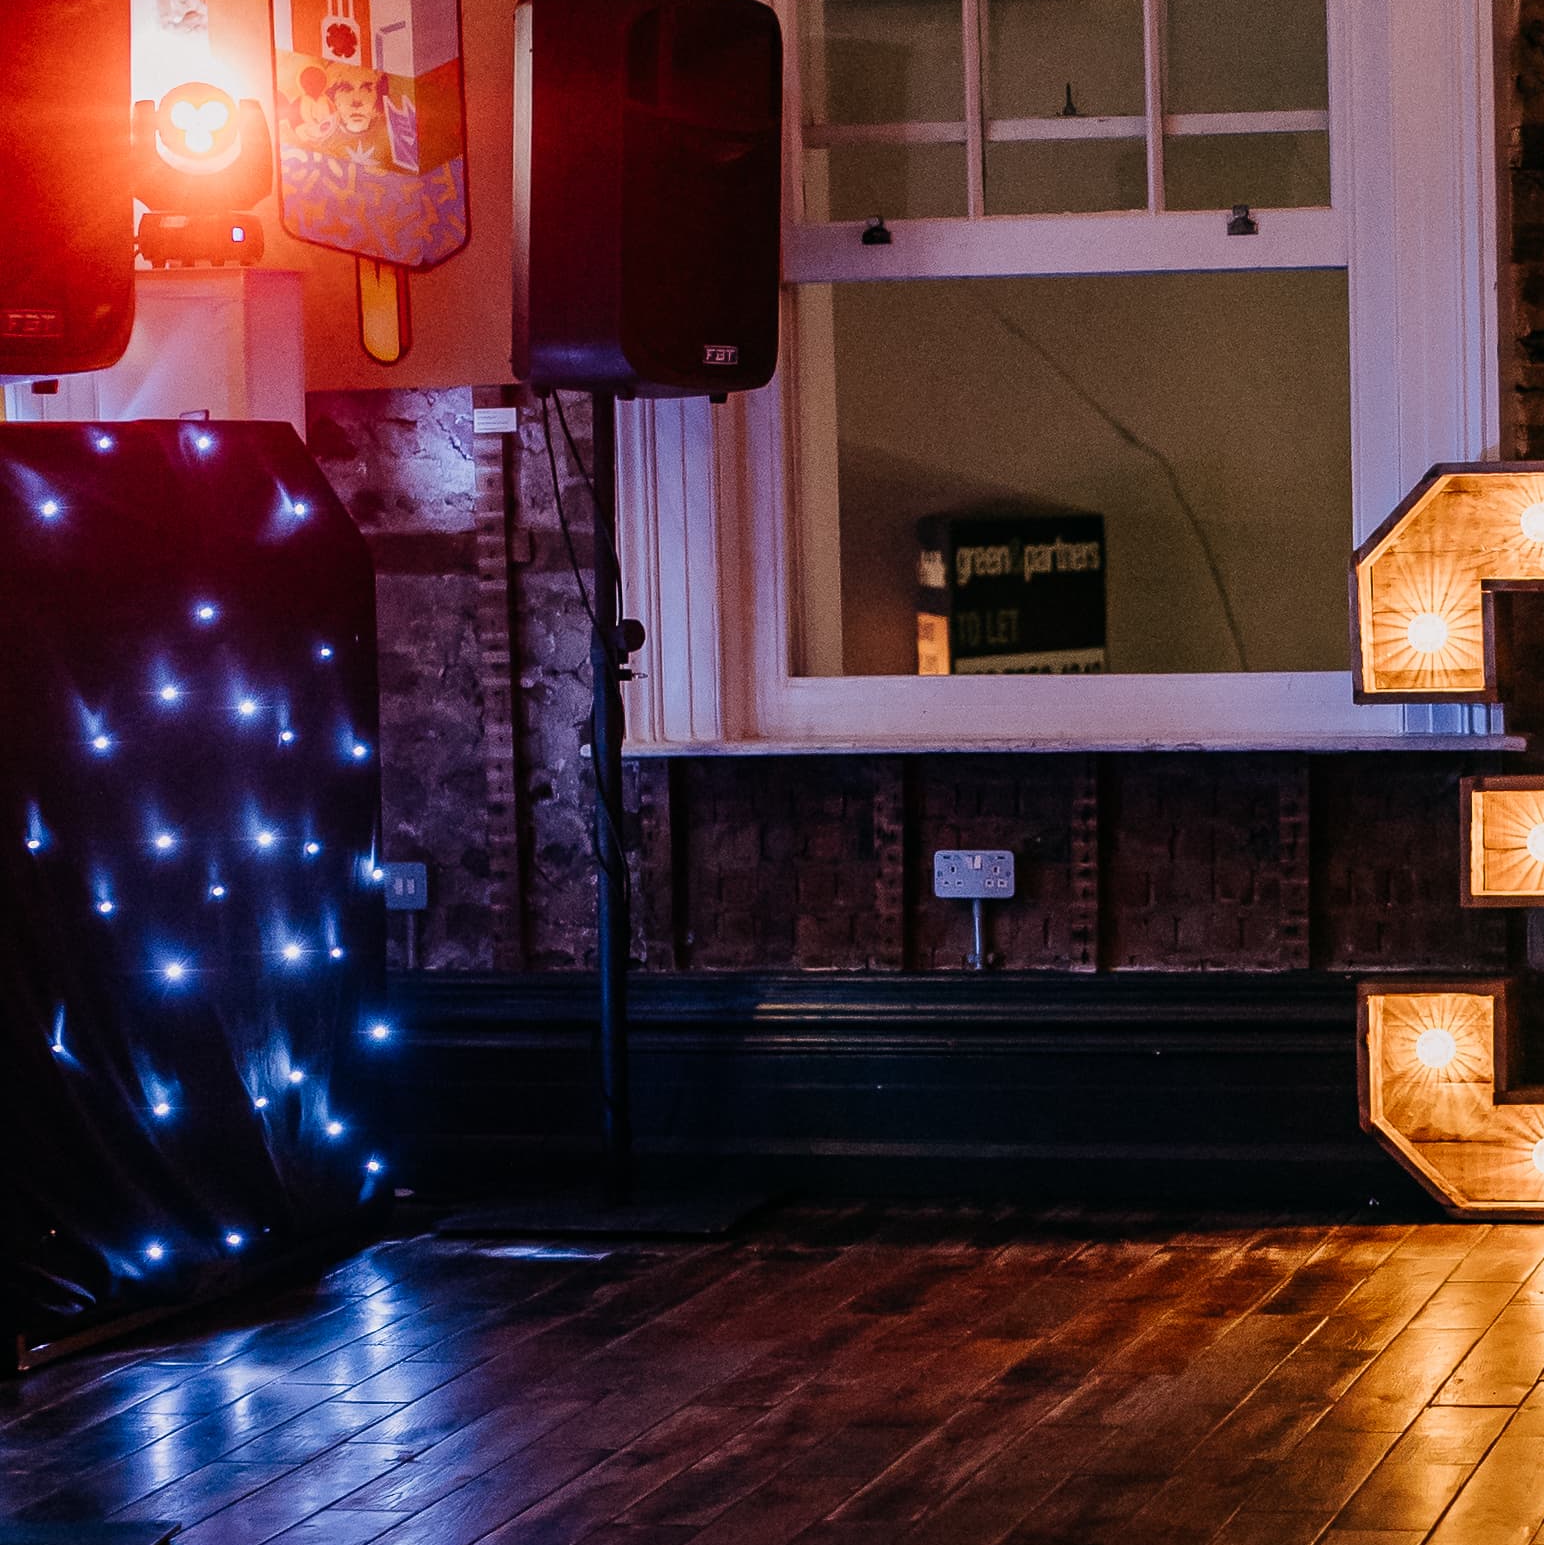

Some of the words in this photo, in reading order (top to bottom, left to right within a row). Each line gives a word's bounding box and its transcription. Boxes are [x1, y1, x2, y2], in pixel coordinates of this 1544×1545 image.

[706, 348, 735, 361] FBT
[956, 545, 1010, 586] green
[959, 610, 980, 646] TO
[986, 608, 1018, 645] LET
